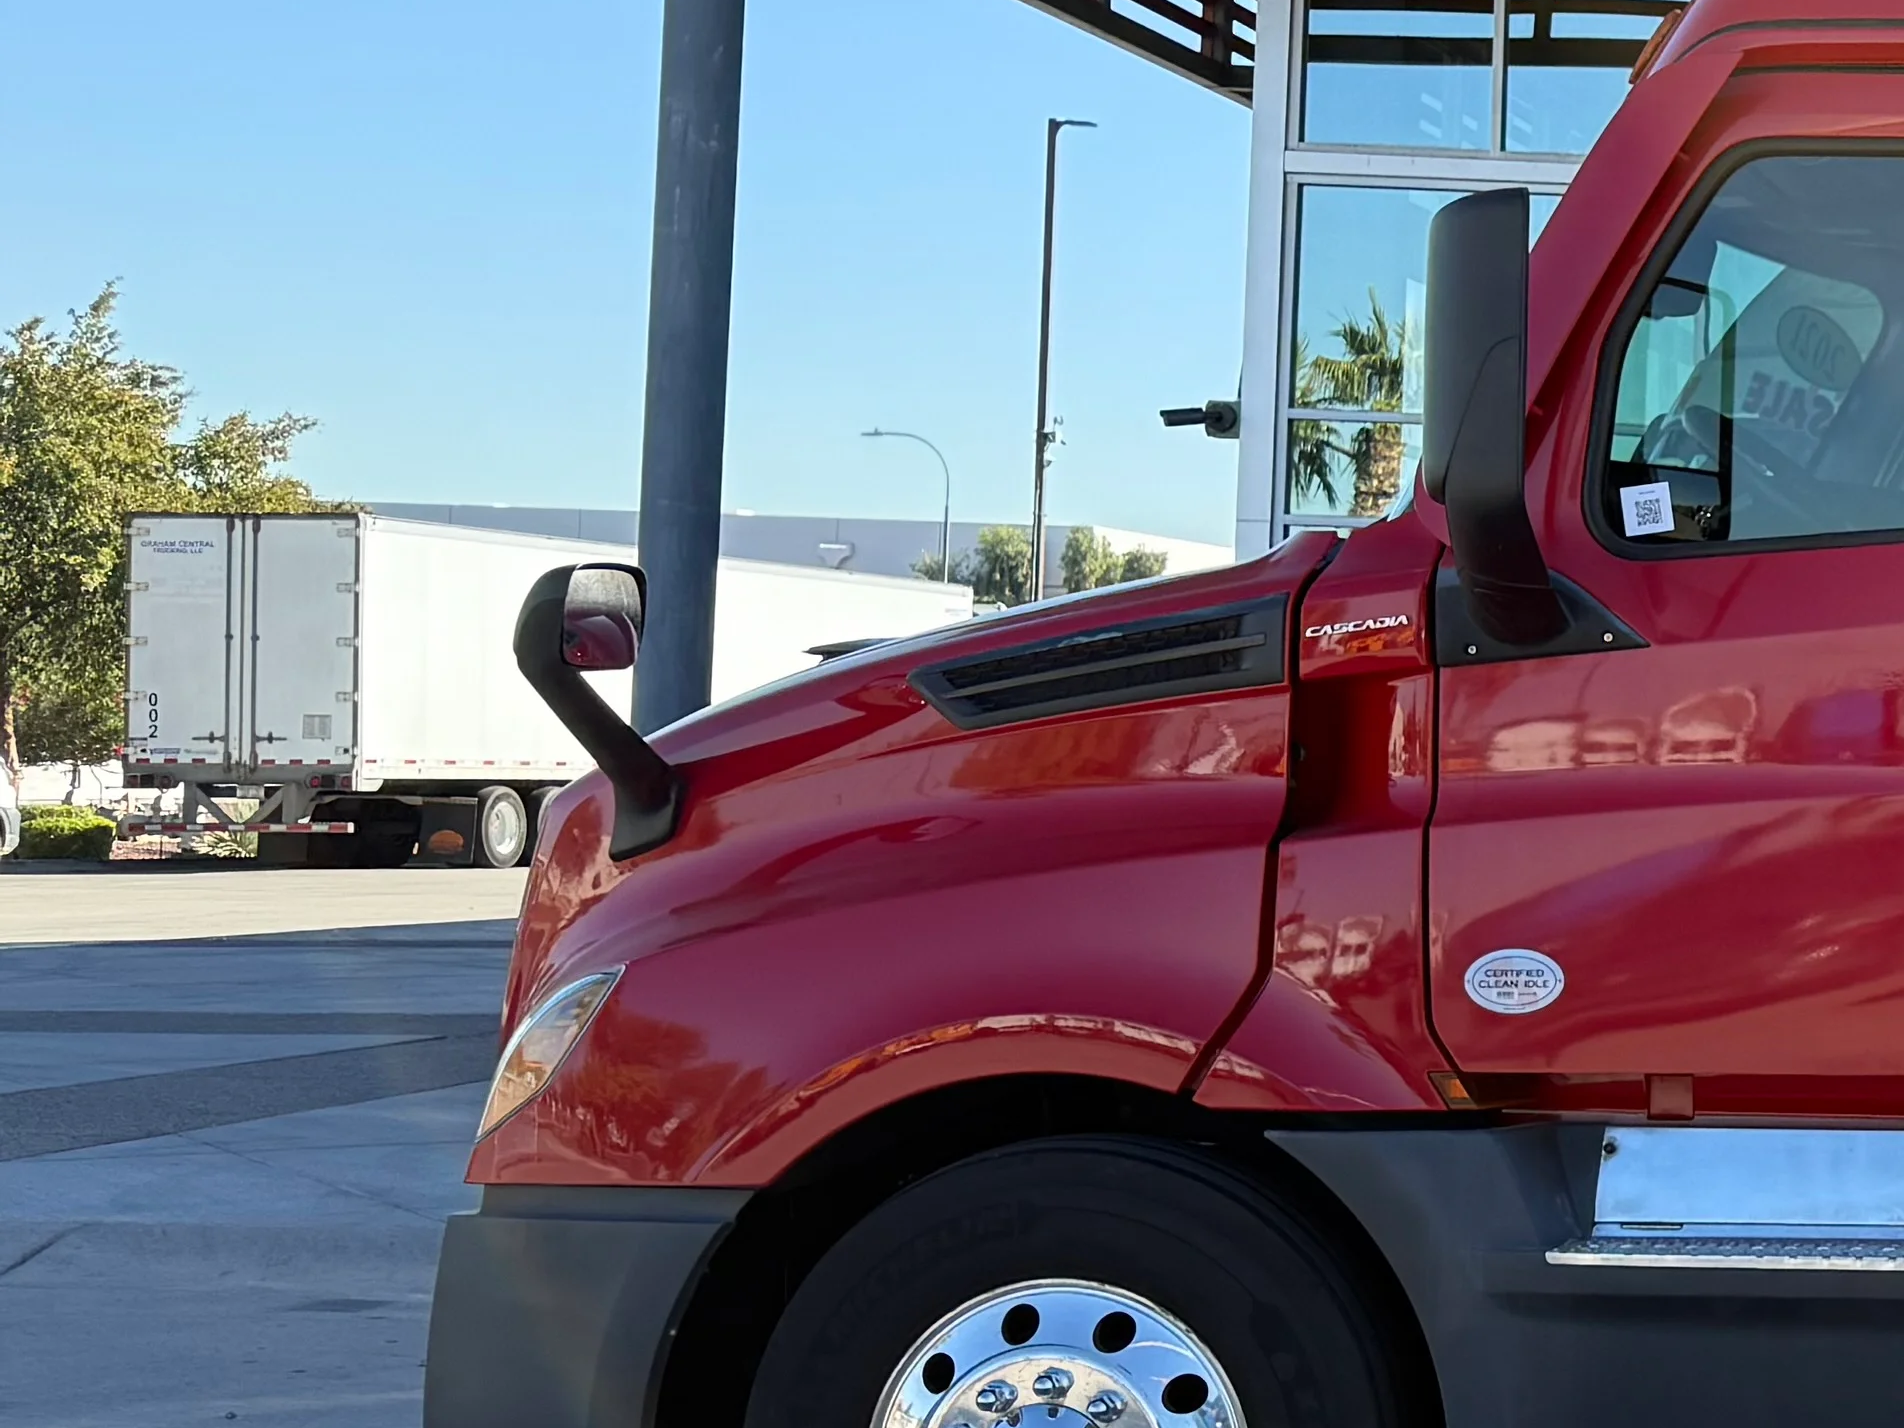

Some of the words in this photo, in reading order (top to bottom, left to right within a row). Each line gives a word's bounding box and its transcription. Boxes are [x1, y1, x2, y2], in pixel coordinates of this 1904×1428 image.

[178, 539, 215, 548] CENTRAL
[1305, 614, 1409, 639] CASCADIA
[1483, 968, 1545, 978] CERTIFIED
[1478, 979, 1519, 989] CLEAN
[1524, 979, 1551, 989] IDLE
